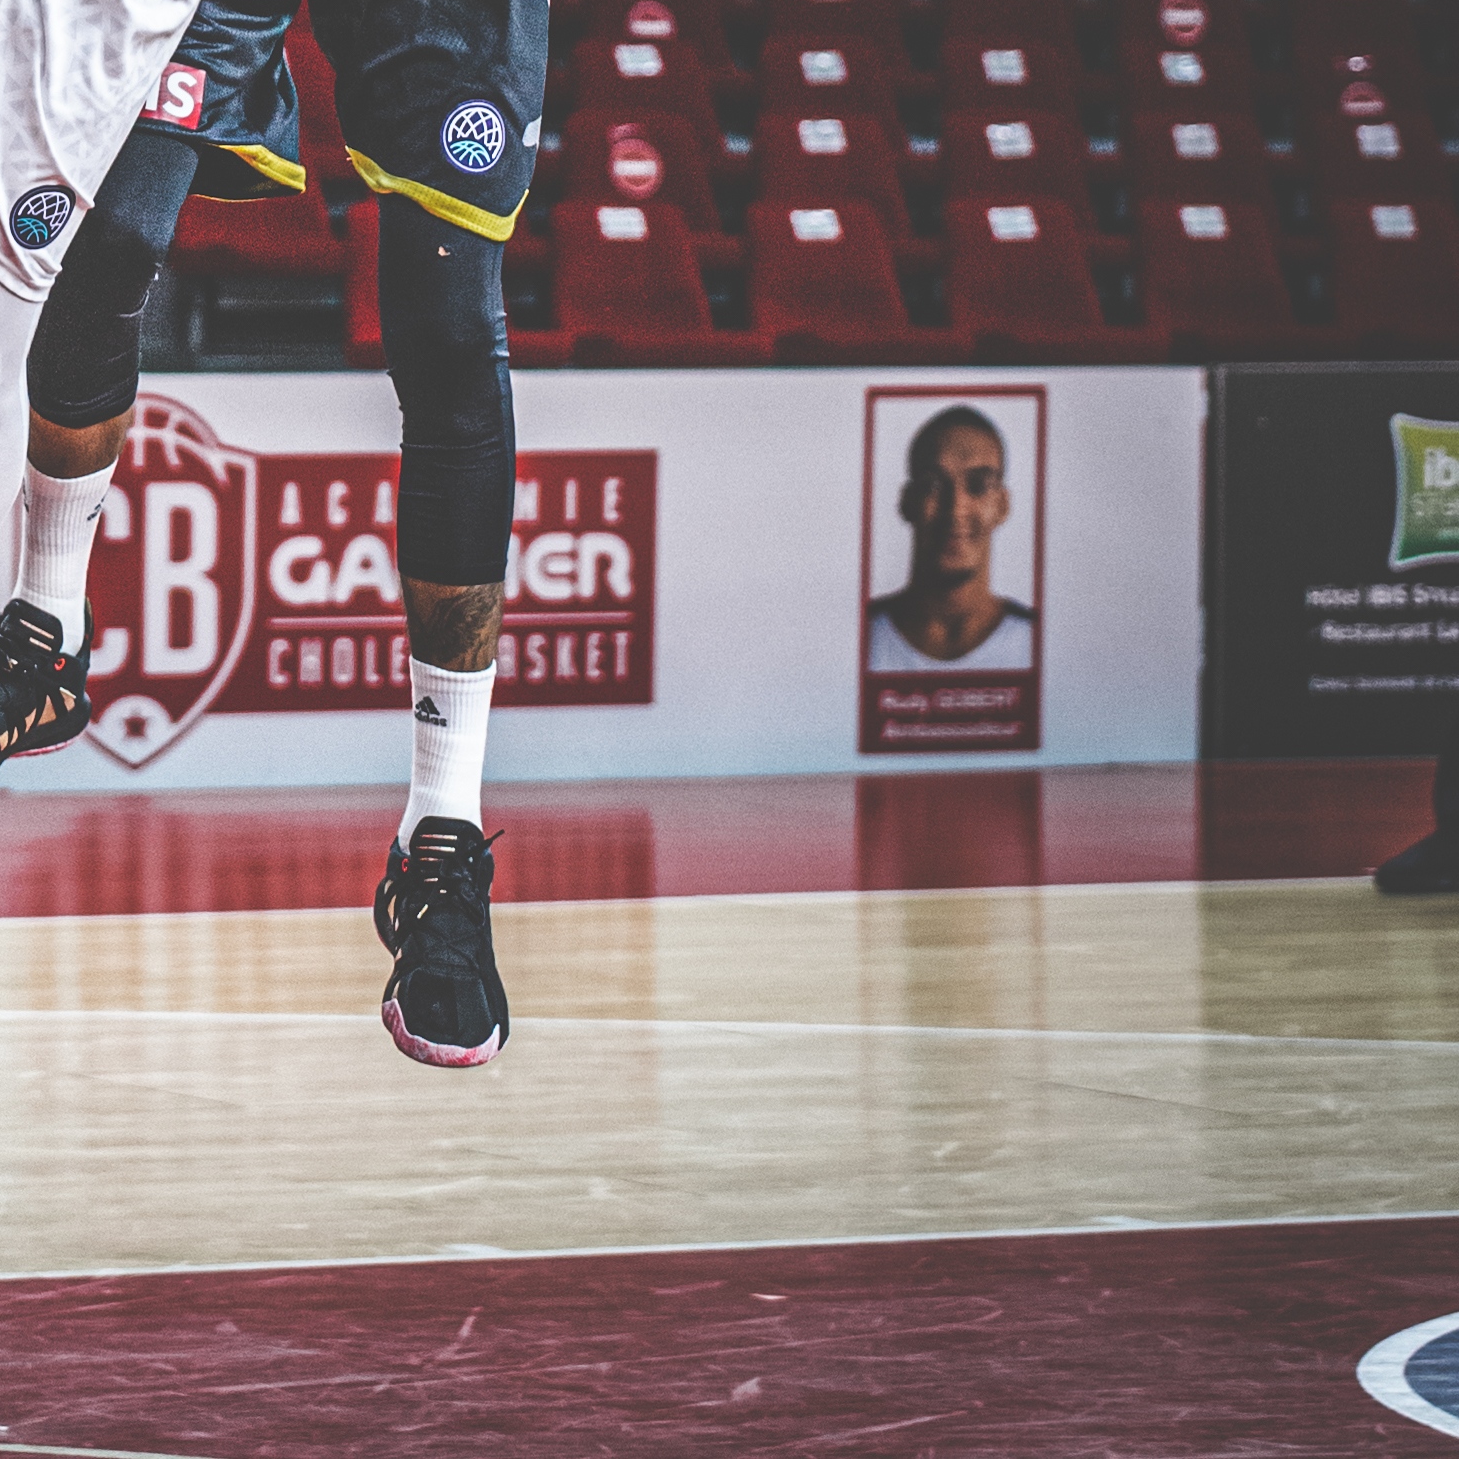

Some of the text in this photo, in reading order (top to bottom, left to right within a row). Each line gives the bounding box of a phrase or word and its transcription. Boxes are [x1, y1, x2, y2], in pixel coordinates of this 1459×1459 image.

[279, 477, 622, 526] ACAMIE
[268, 632, 632, 685] CHOLE ASKET
